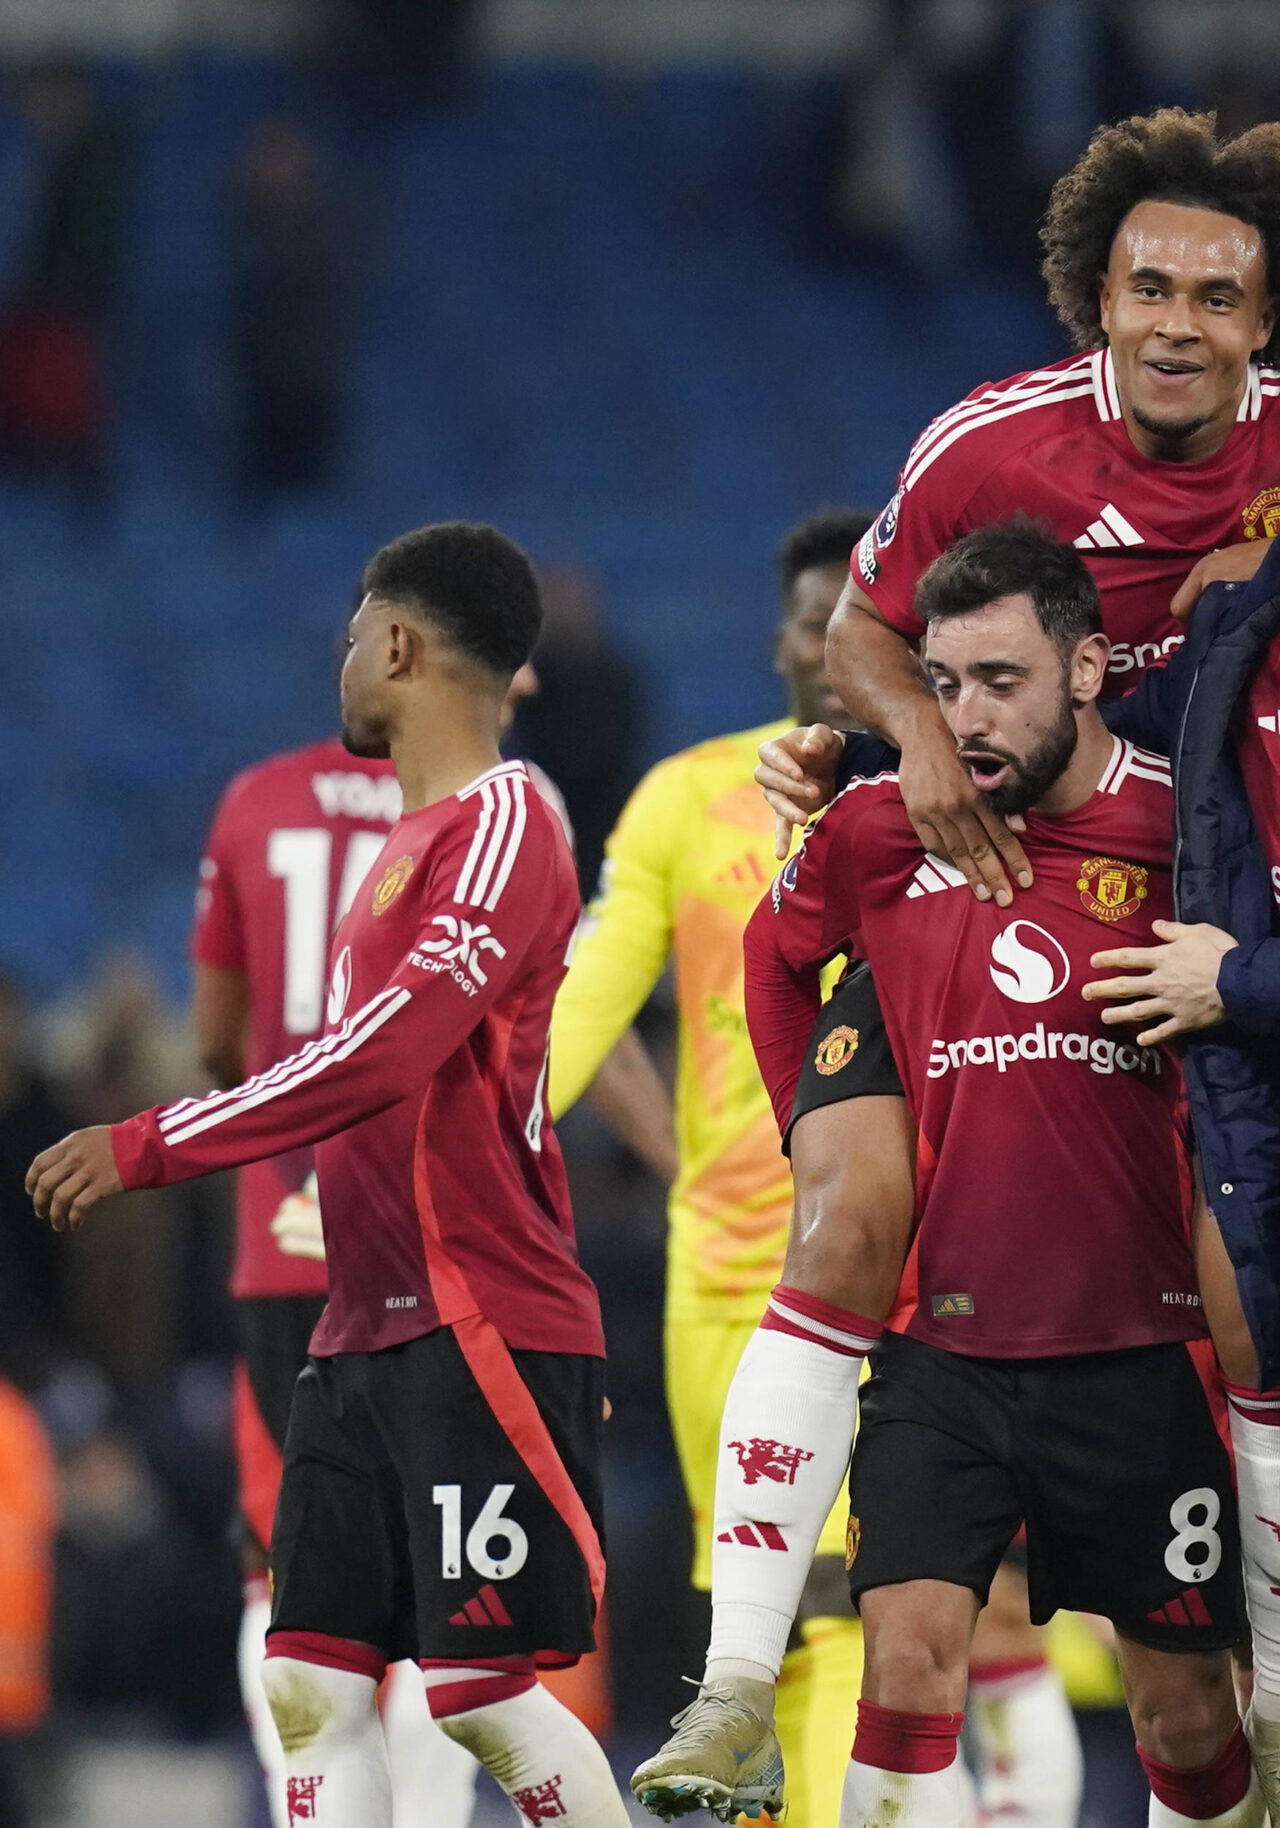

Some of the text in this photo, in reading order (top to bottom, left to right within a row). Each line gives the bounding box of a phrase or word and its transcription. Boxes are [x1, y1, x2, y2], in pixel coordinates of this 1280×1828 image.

[1089, 901, 1130, 917] UNITED
[418, 914, 507, 987] DXC
[926, 1022, 1161, 1078] Snapdragon
[432, 1484, 529, 1580] 16
[1163, 1487, 1223, 1584] 8
